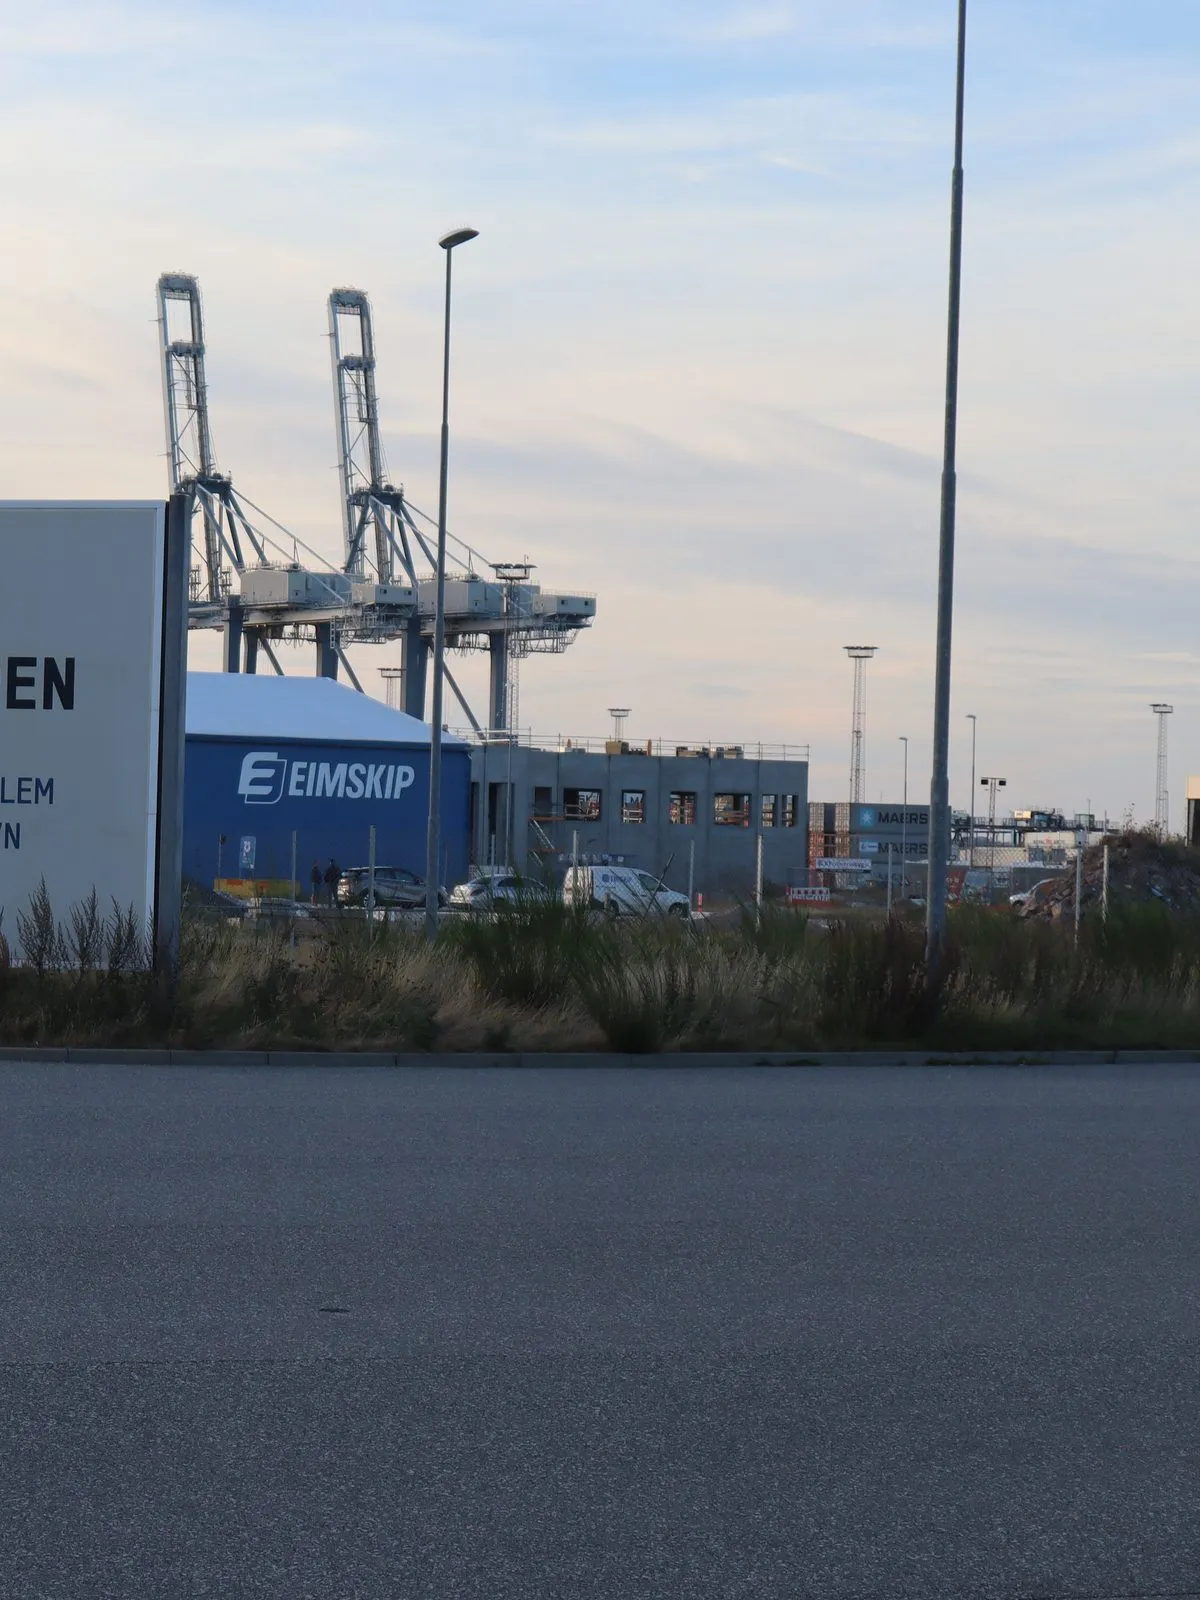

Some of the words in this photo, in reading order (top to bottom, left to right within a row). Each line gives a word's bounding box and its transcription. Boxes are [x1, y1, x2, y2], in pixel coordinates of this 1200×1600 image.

[288, 761, 415, 799] EIMSKIP
[878, 811, 930, 825] MAERS
[878, 842, 930, 854] MAERS
